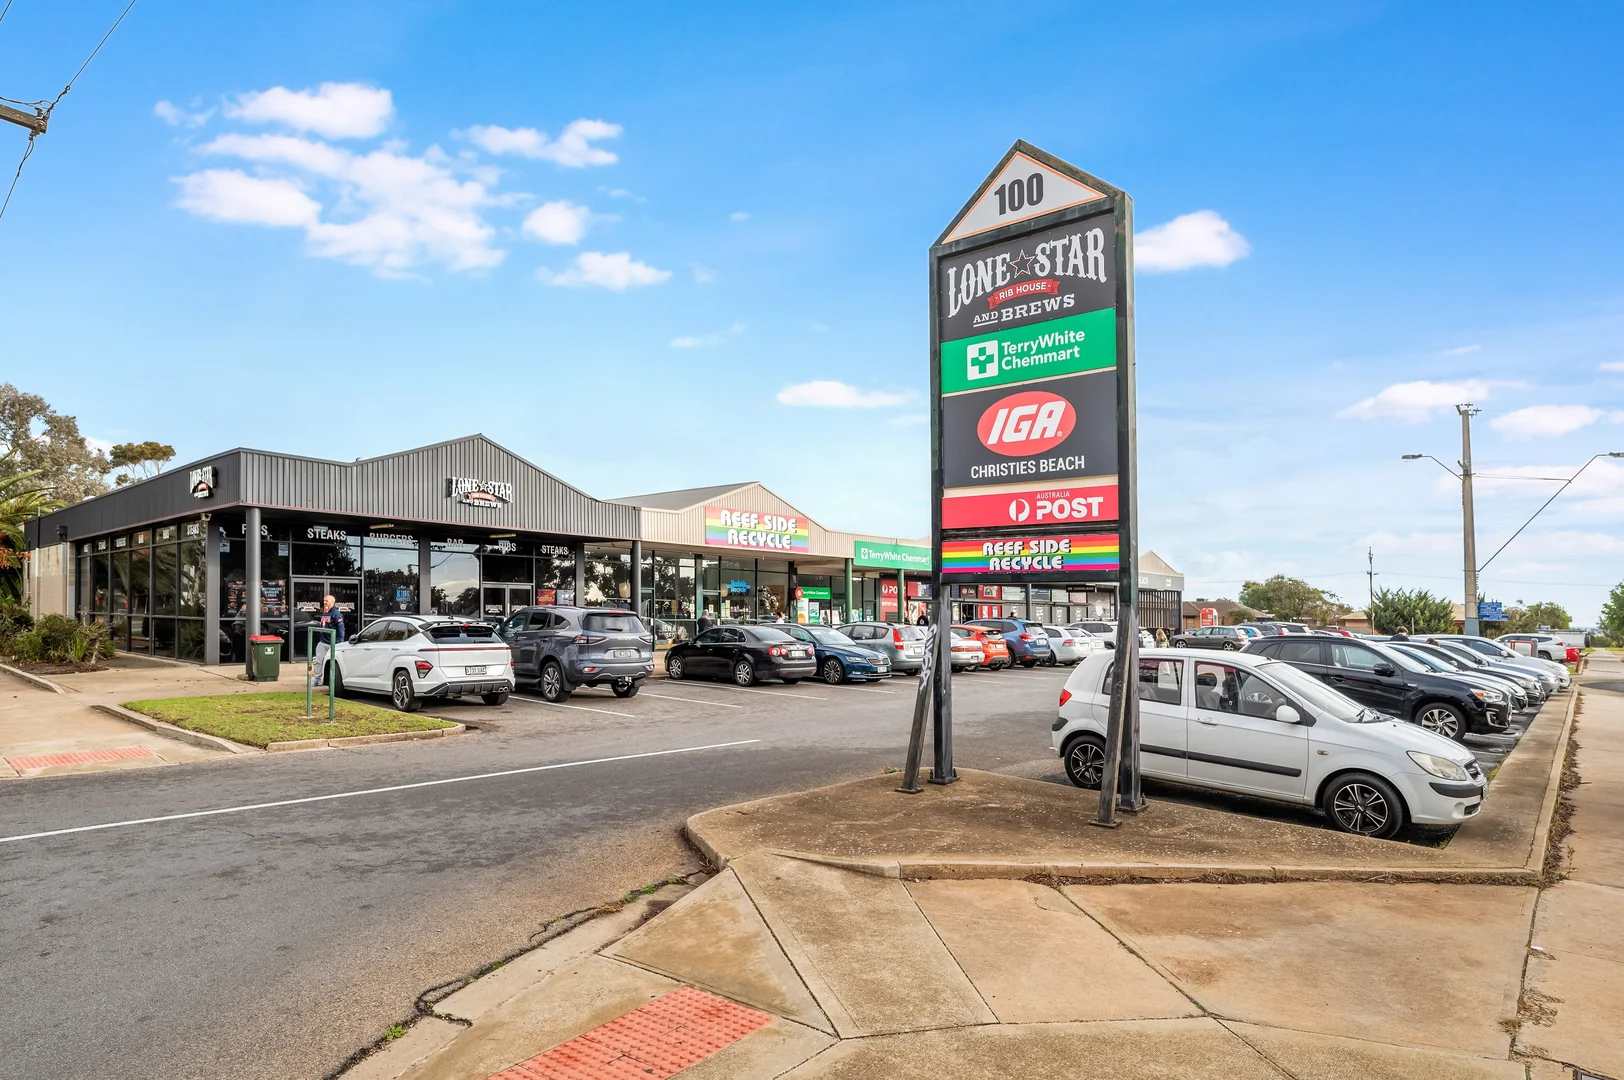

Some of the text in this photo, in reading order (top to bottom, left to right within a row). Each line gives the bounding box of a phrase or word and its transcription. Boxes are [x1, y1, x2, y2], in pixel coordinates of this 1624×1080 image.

[994, 172, 1044, 216] 100
[947, 227, 1108, 318] LONE STAR
[999, 281, 1047, 301] RIB HOUSE
[973, 293, 1075, 325] AND BREWS
[1001, 330, 1086, 356] TerryWhite
[1001, 345, 1080, 371] Chemmart
[986, 400, 1067, 445] IGA
[970, 455, 1085, 479] CHRISTIES BEACH
[451, 476, 513, 503] LONE STAR
[1036, 491, 1070, 500] AUSTRALIA
[473, 500, 502, 508] BREWS
[1036, 496, 1104, 520] POST
[720, 509, 797, 533] REEF SIDE
[307, 528, 347, 541] STEAKS
[369, 532, 414, 545] BURGERS
[447, 538, 464, 548] BAR
[727, 528, 792, 549] RECYCLE
[498, 542, 517, 552] RIBS
[541, 545, 569, 555] STEAKS
[868, 549, 930, 563] TerryWhite Chemmart
[982, 538, 1072, 556] REEF SIDE
[989, 555, 1064, 571] RECYCLE
